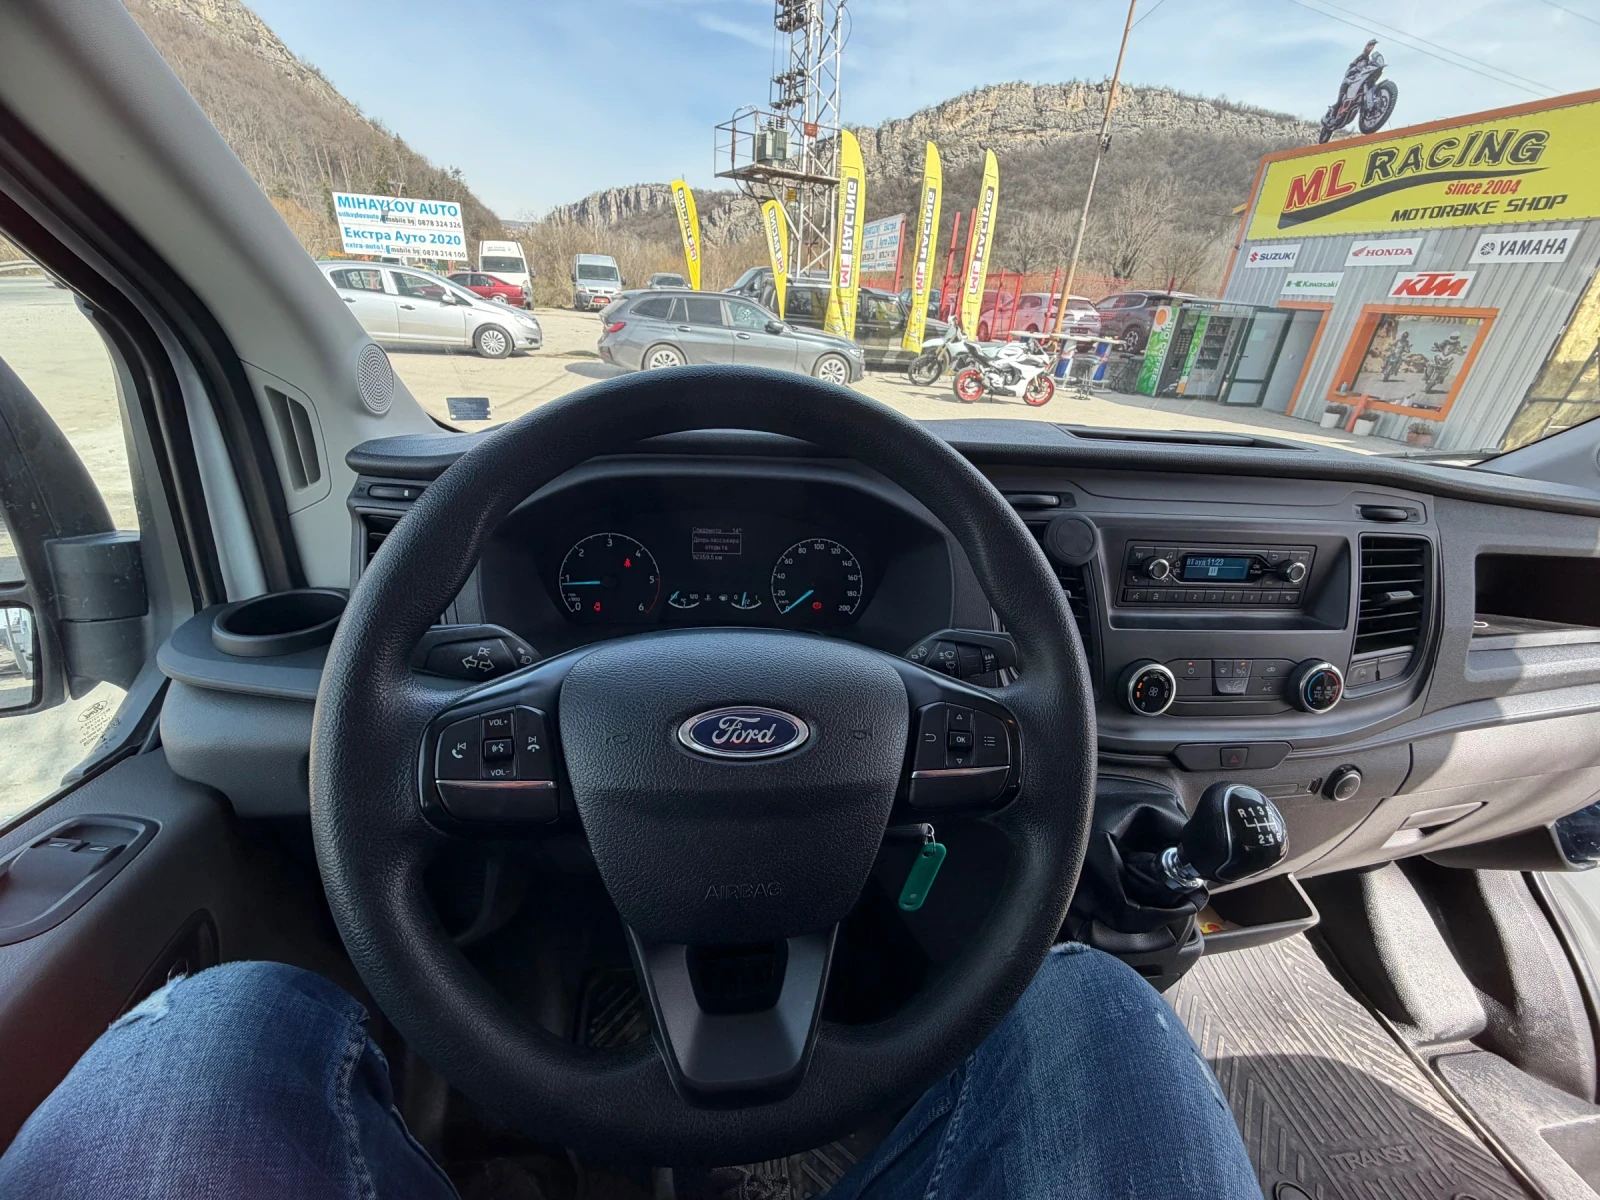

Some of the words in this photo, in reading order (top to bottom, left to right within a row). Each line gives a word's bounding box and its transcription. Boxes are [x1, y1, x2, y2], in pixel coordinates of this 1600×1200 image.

[1282, 159, 1357, 214] ML
[1361, 129, 1551, 188] RACING
[1444, 180, 1483, 196] since
[1482, 179, 1522, 195] 2004
[337, 195, 415, 213] MIHAYLOV
[419, 203, 458, 217] AUTO
[1390, 200, 1500, 222] MOTORBIKE
[1503, 194, 1568, 214] SHOP
[417, 218, 433, 227] 0878
[344, 226, 391, 243] Екстра
[429, 233, 461, 246] 2020
[422, 247, 439, 257] 0878
[454, 250, 465, 258] 100
[1365, 247, 1413, 257] HONDA
[1497, 237, 1568, 257] YAMAHA
[1259, 251, 1295, 261] SUZUKI
[1302, 280, 1338, 288] Kawasaki
[1391, 273, 1470, 297] KTM
[606, 538, 613, 547] 3
[578, 548, 585, 557] 2
[635, 549, 641, 558] 4
[1207, 558, 1225, 566] 11:23
[649, 575, 655, 584] 5
[575, 602, 581, 611] 0
[638, 602, 644, 611] 6
[711, 716, 776, 745] Ford
[956, 736, 966, 744] OK
[1237, 808, 1248, 818] R
[1247, 807, 1256, 817] 1
[1256, 806, 1265, 816] 3
[1265, 805, 1273, 816] 5
[1258, 834, 1265, 844] 2
[1266, 835, 1275, 845] 4
[1276, 832, 1282, 843] 6
[704, 882, 783, 901] AIRBAG
[1328, 1145, 1416, 1172] TRANSIT
